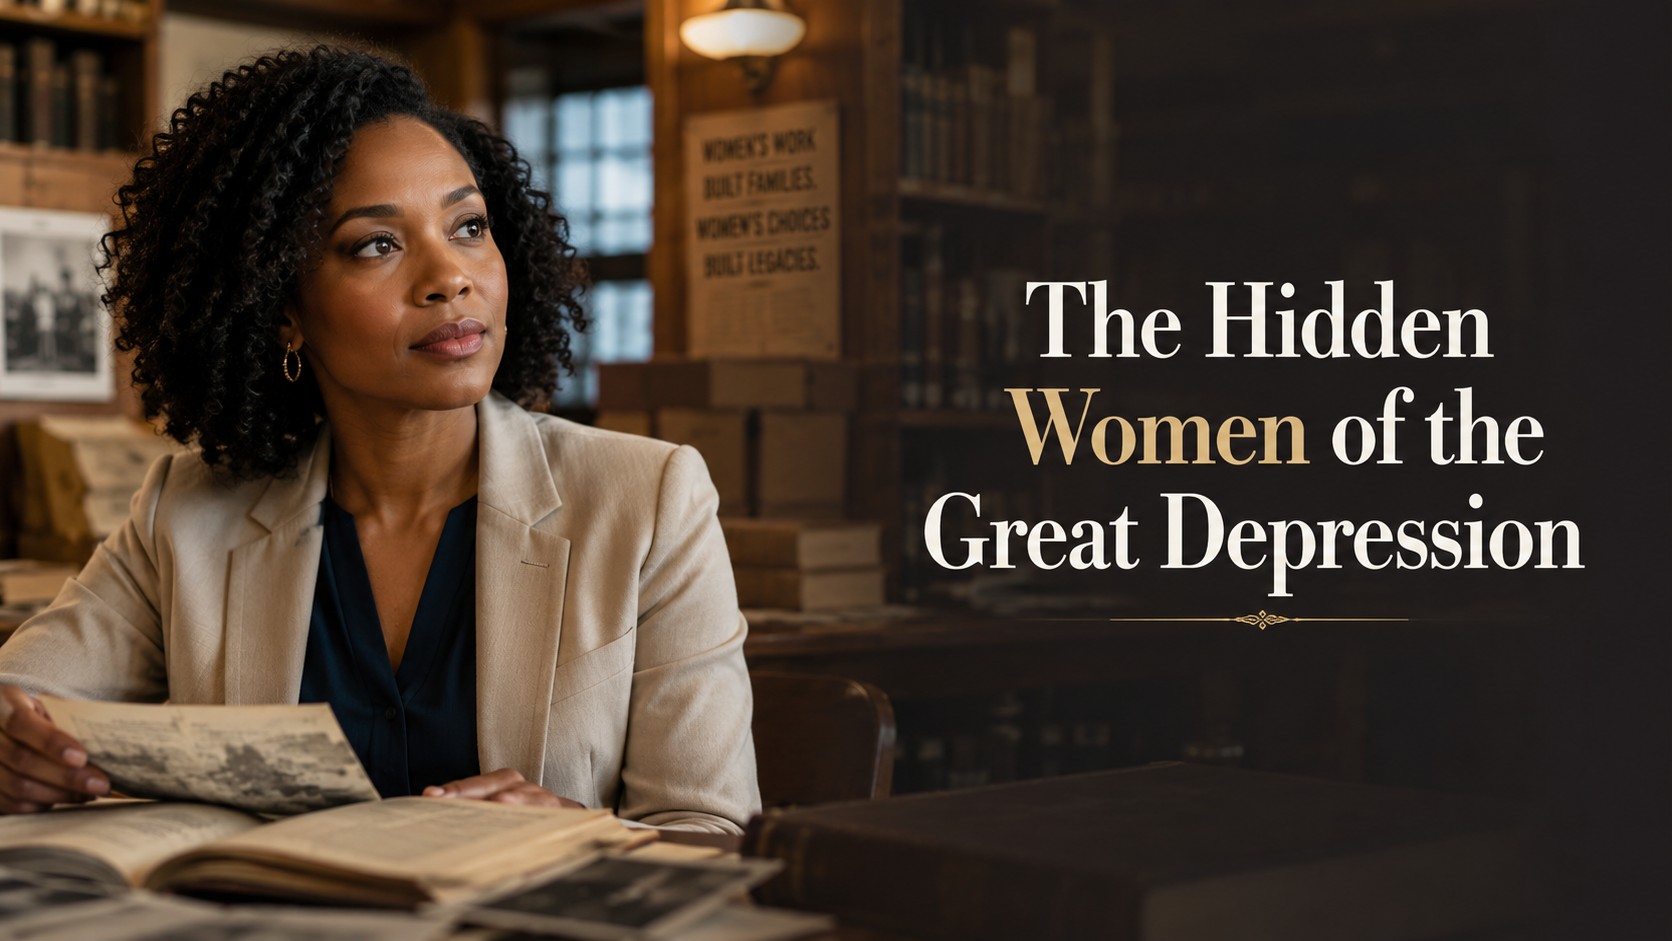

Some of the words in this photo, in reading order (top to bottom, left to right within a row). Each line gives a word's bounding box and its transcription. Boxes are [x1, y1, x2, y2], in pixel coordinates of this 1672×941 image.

[703, 133, 768, 163] WOMEN'S
[773, 129, 817, 157] WORK
[704, 173, 743, 200] BUILT
[748, 165, 817, 195] FAMILIES.
[697, 212, 763, 241] WOMEN'S
[767, 206, 831, 234] CHOICES
[704, 251, 743, 278] BUILT
[748, 247, 820, 275] LEGACIES.
